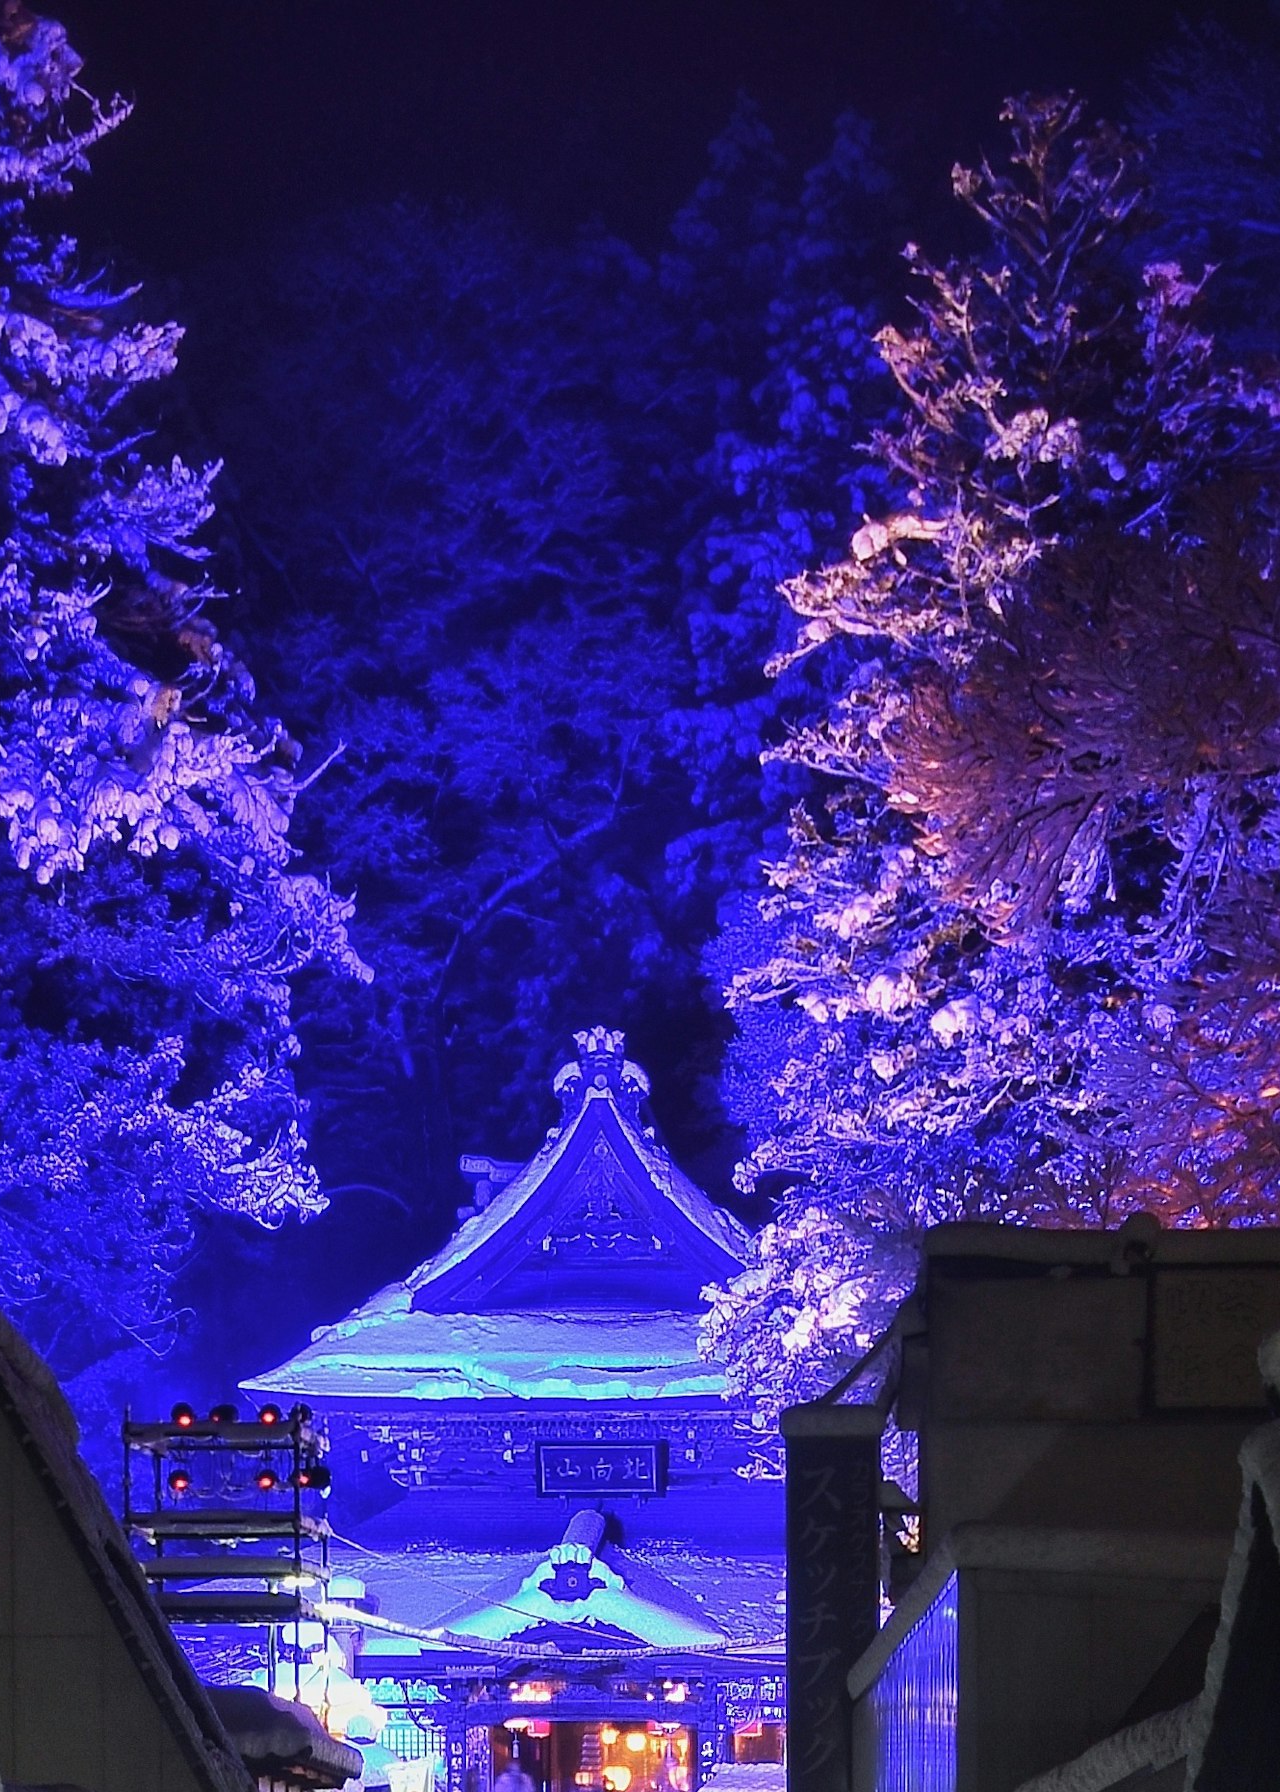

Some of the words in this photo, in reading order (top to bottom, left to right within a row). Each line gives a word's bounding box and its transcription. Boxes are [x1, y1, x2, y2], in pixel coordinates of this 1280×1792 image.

[796, 1465, 842, 1776] スケッチブック
